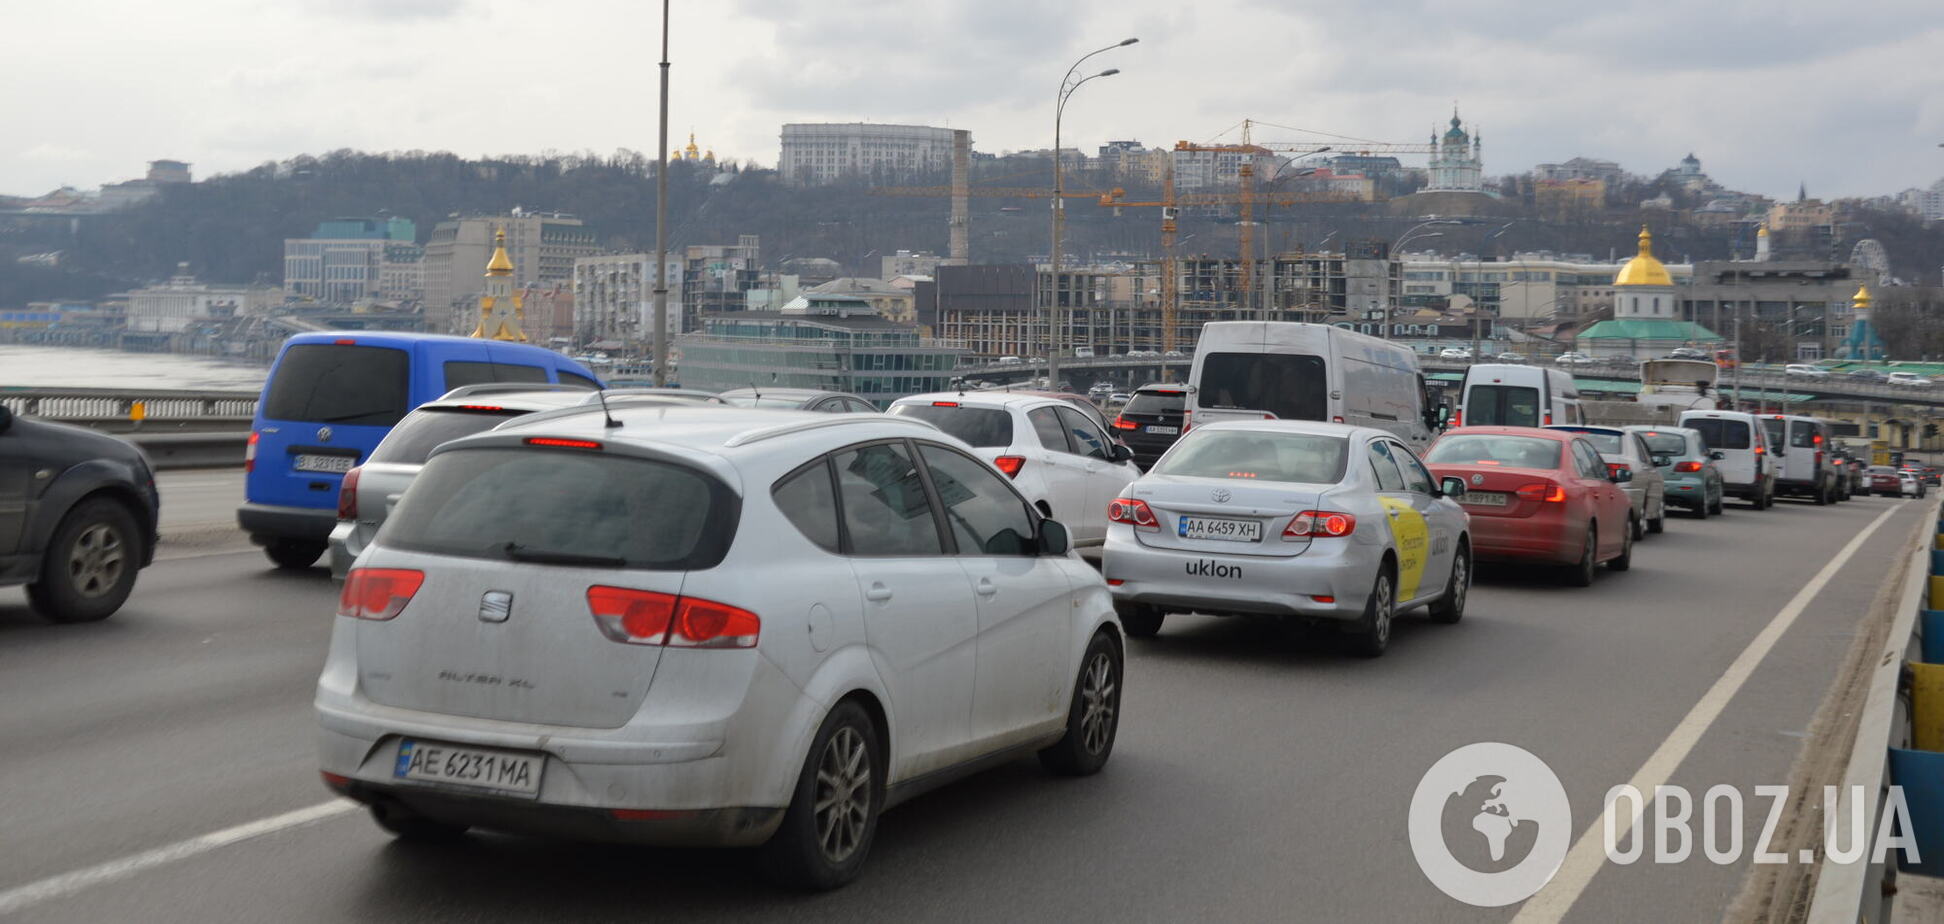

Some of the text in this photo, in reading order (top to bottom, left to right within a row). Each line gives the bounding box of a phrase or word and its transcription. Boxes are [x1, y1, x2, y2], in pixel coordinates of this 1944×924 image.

[1187, 519, 1257, 537] AA 6459 XH
[1432, 529, 1450, 555] uklon
[1185, 559, 1242, 579] uklon
[408, 747, 531, 788] AE 6231 MA
